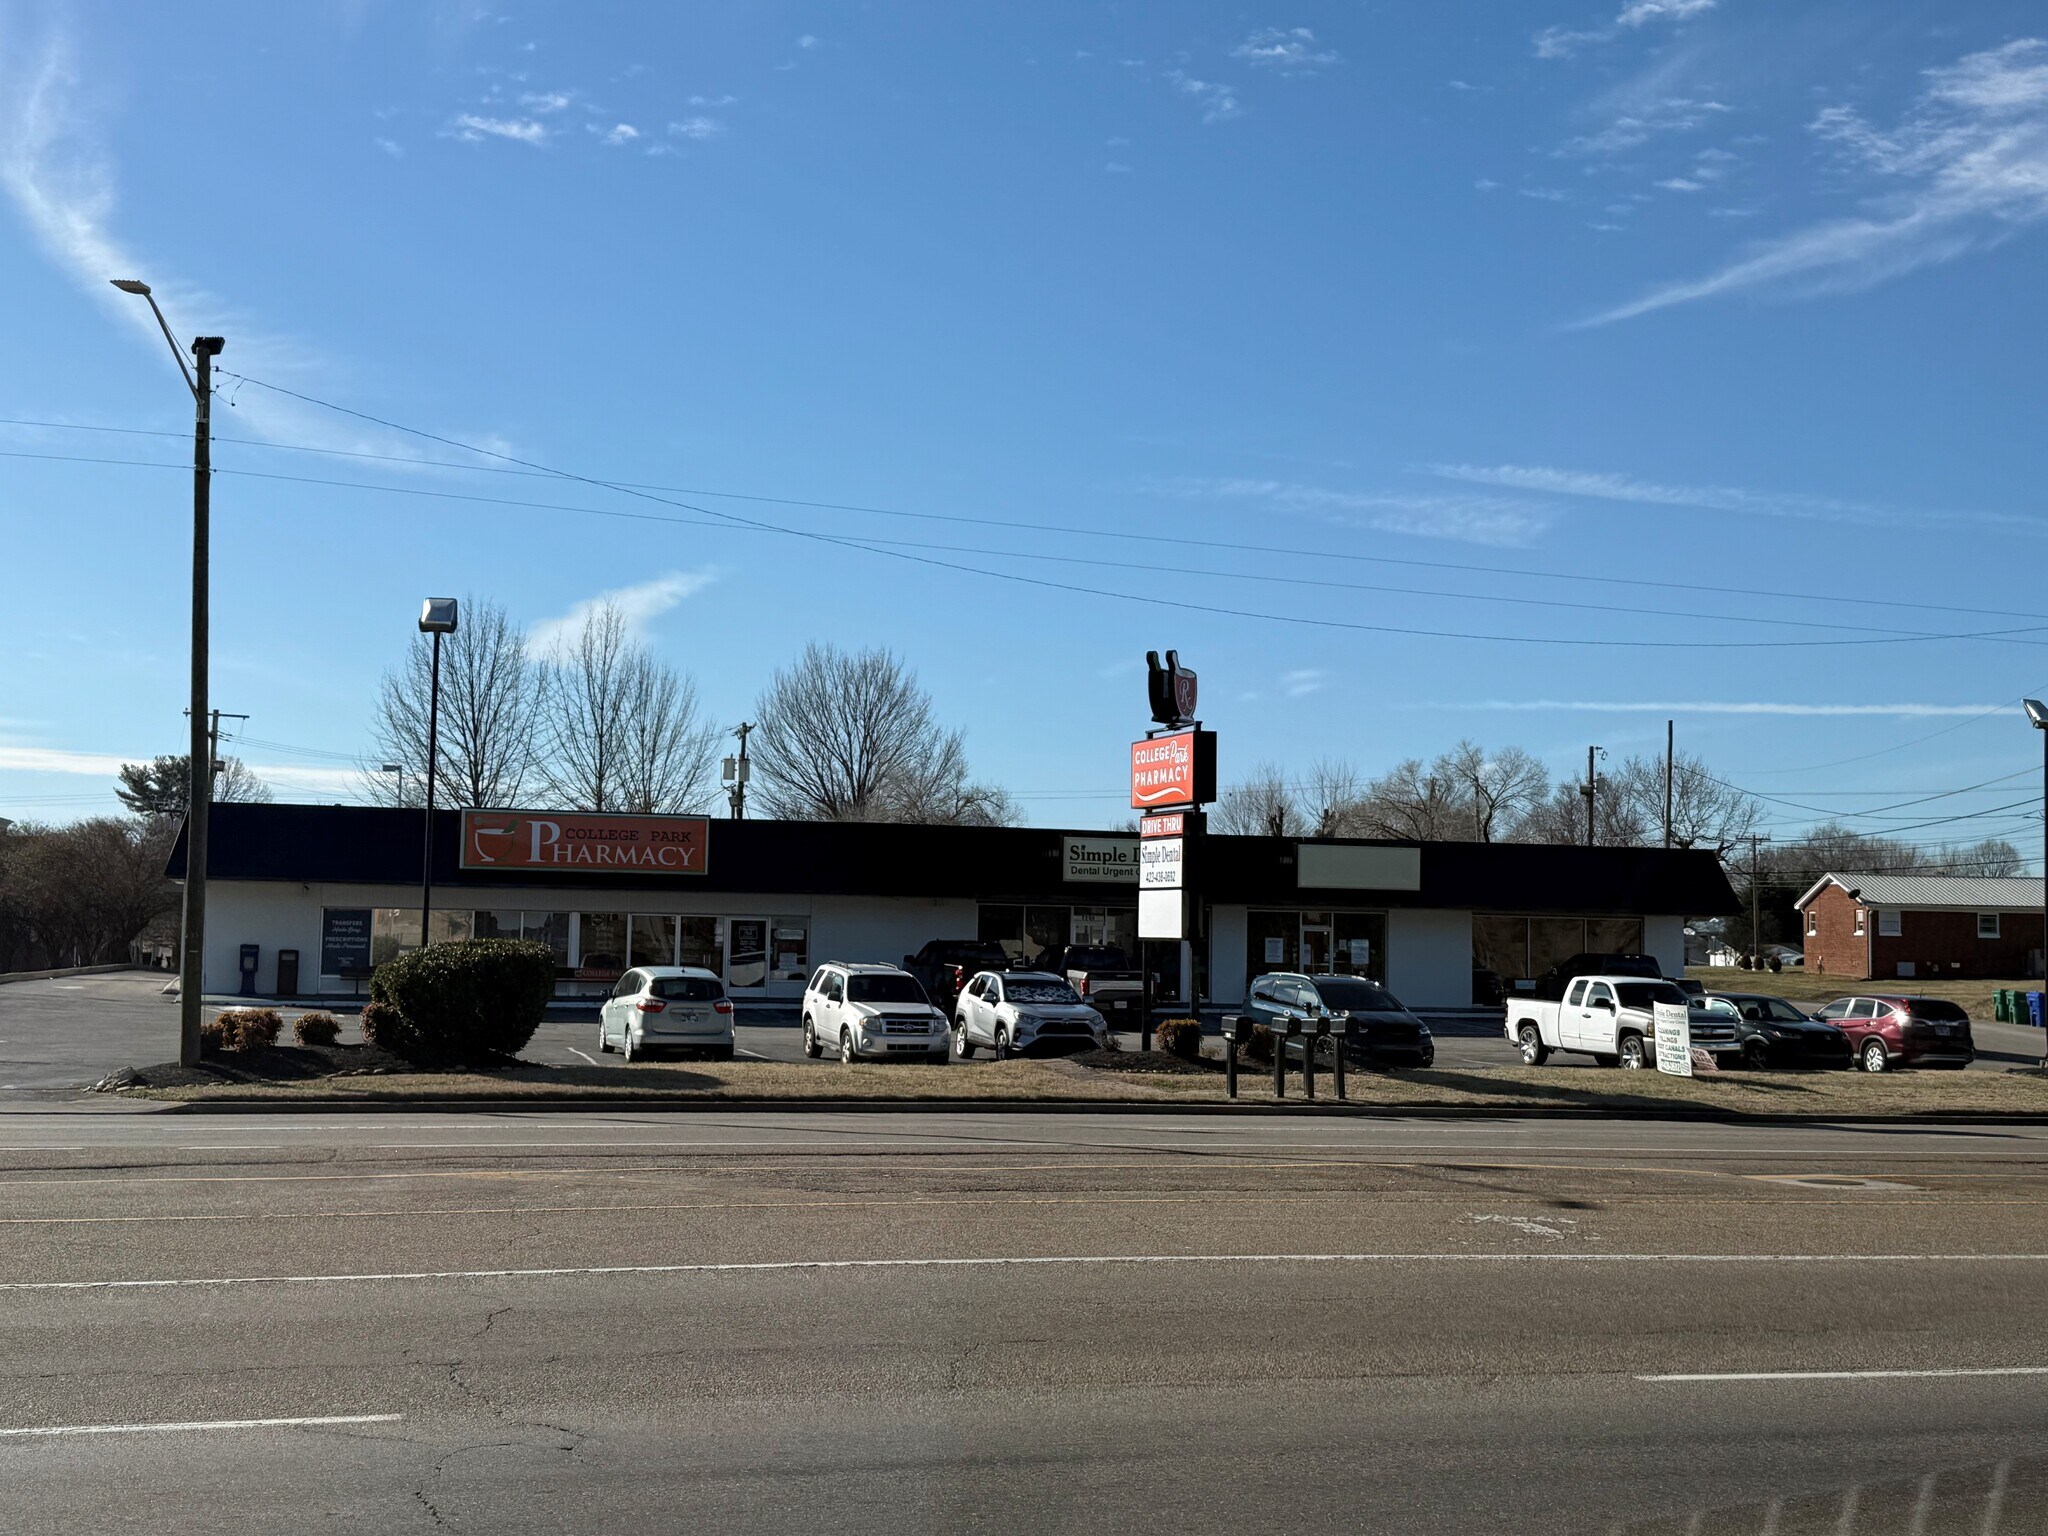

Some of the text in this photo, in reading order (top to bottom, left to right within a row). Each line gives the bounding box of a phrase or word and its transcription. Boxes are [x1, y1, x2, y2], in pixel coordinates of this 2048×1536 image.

[1135, 740, 1189, 765] COLLEGE Park
[1134, 765, 1189, 787] PHARMACY
[1142, 816, 1182, 834] DRIVE THRU
[526, 820, 696, 867] PHARMACY
[566, 828, 692, 843] COLLEGE PARK
[1070, 844, 1127, 865] Simple
[1142, 845, 1161, 868] Simple
[1162, 844, 1181, 863] Dental
[1071, 866, 1100, 875] Dental
[1103, 867, 1133, 877] Urgent
[583, 969, 611, 977] COLLEGE
[1666, 1010, 1686, 1018] Dental
[1658, 1051, 1686, 1060] TRACTIONS
[1665, 1045, 1685, 1053] CANALS
